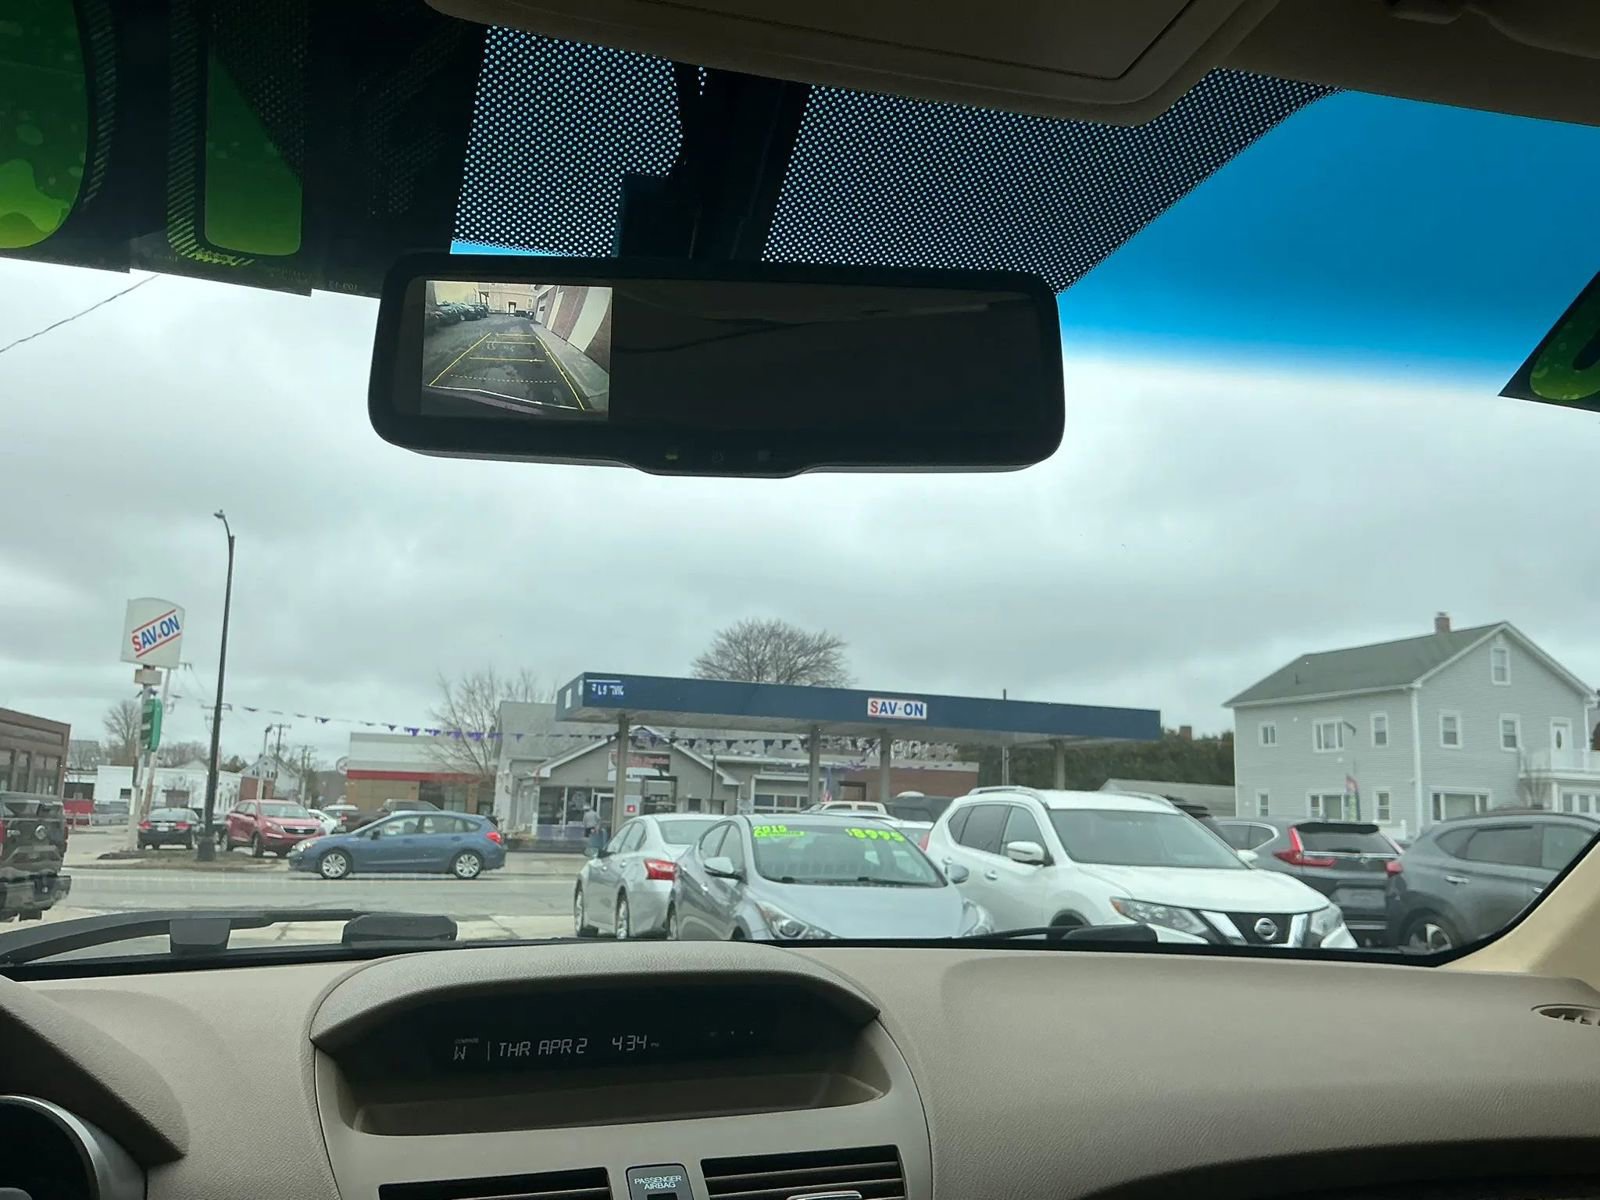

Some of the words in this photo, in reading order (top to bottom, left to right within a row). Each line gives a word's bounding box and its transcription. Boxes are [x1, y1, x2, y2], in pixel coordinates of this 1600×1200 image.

[453, 1046, 466, 1060] W
[499, 1041, 531, 1057] THR
[538, 1039, 573, 1055] APR
[576, 1038, 588, 1054] 2
[634, 1175, 682, 1185] PASSENGER
[644, 1182, 676, 1190] AIRBAG
